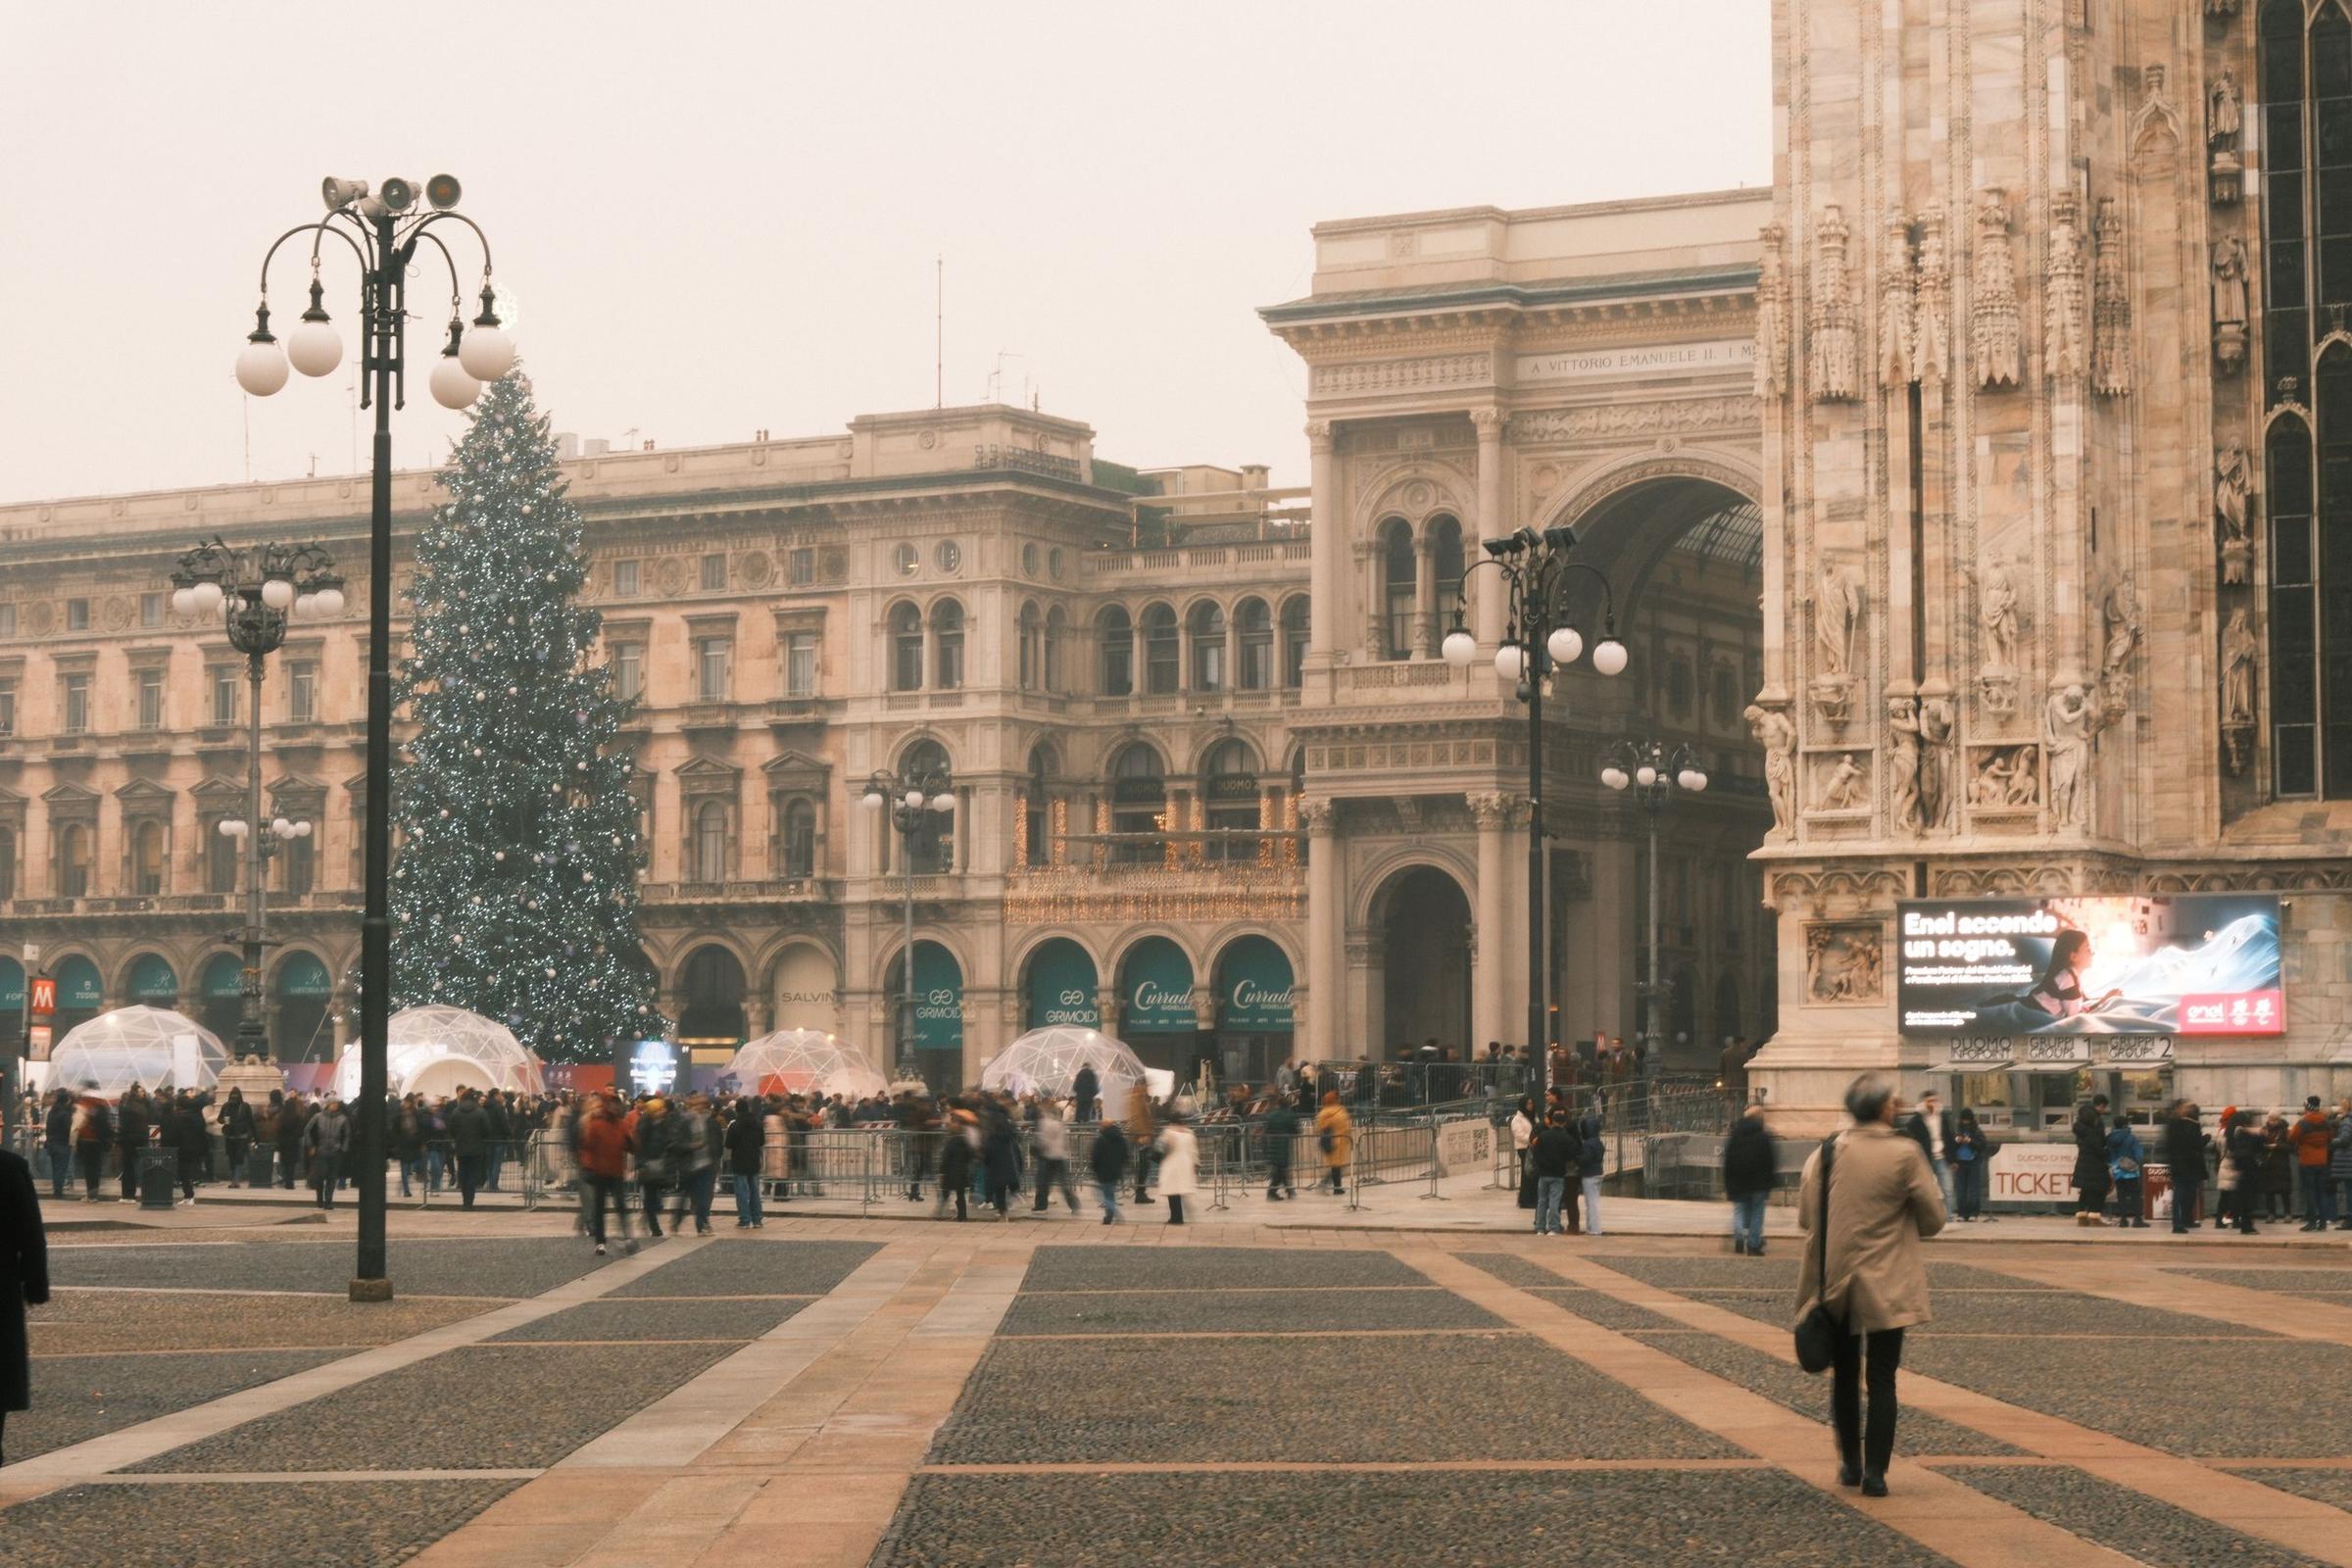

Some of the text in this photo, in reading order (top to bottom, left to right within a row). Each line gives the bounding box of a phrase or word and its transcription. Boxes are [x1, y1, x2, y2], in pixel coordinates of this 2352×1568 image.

[1532, 363, 1541, 373] A
[1549, 357, 1612, 371] VITTORIO
[1620, 350, 1696, 367] EMANUELE
[1905, 909, 2057, 935] Enel accende
[1905, 939, 2016, 962] un sogno.
[33, 986, 53, 1007] M
[1135, 981, 1195, 1010] Currad
[1046, 1010, 1098, 1022] GRIMOLDI
[2187, 1003, 2223, 1018] enel
[1951, 1036, 2011, 1051] DUOMO
[2030, 1036, 2075, 1048] GRUPPI
[2082, 1036, 2091, 1058] 1
[2109, 1036, 2154, 1048] GRUPPI
[2160, 1036, 2172, 1057] 2
[1996, 1172, 2080, 1195] TICKET
